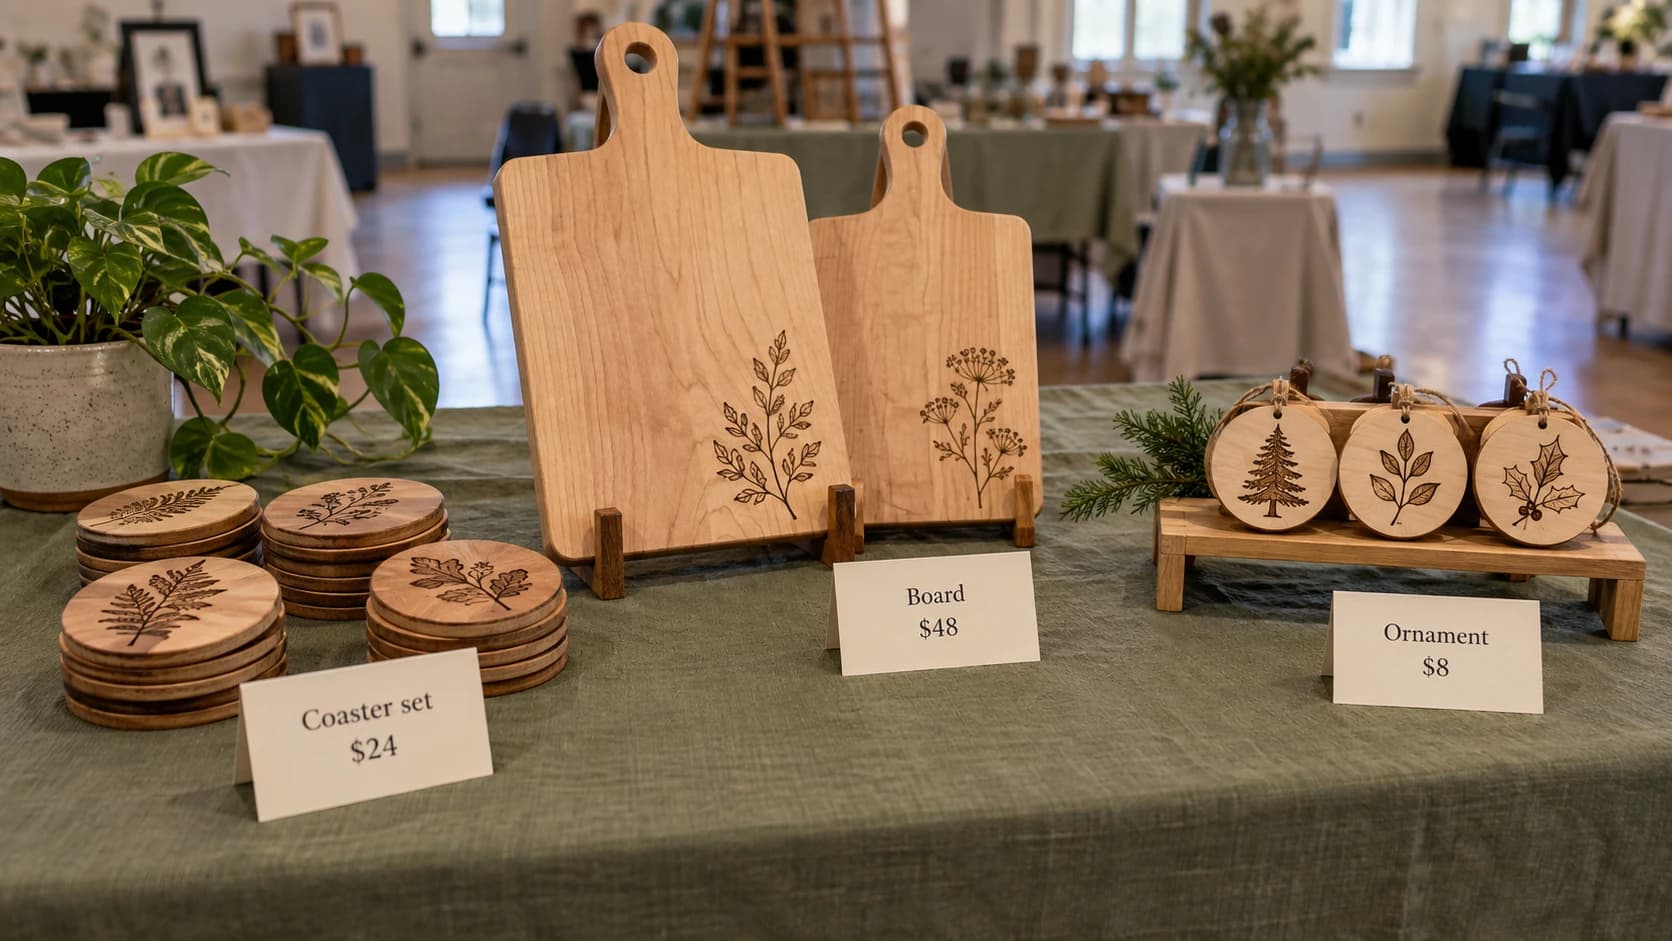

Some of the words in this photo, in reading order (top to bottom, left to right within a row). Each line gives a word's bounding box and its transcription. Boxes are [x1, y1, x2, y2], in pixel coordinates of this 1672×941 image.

[906, 583, 966, 606] Board
[919, 616, 959, 641] $48
[1383, 623, 1489, 646] Ornament
[1422, 655, 1449, 678] $8
[301, 702, 393, 731] Coaster
[400, 693, 433, 714] set
[350, 734, 398, 764] $24
